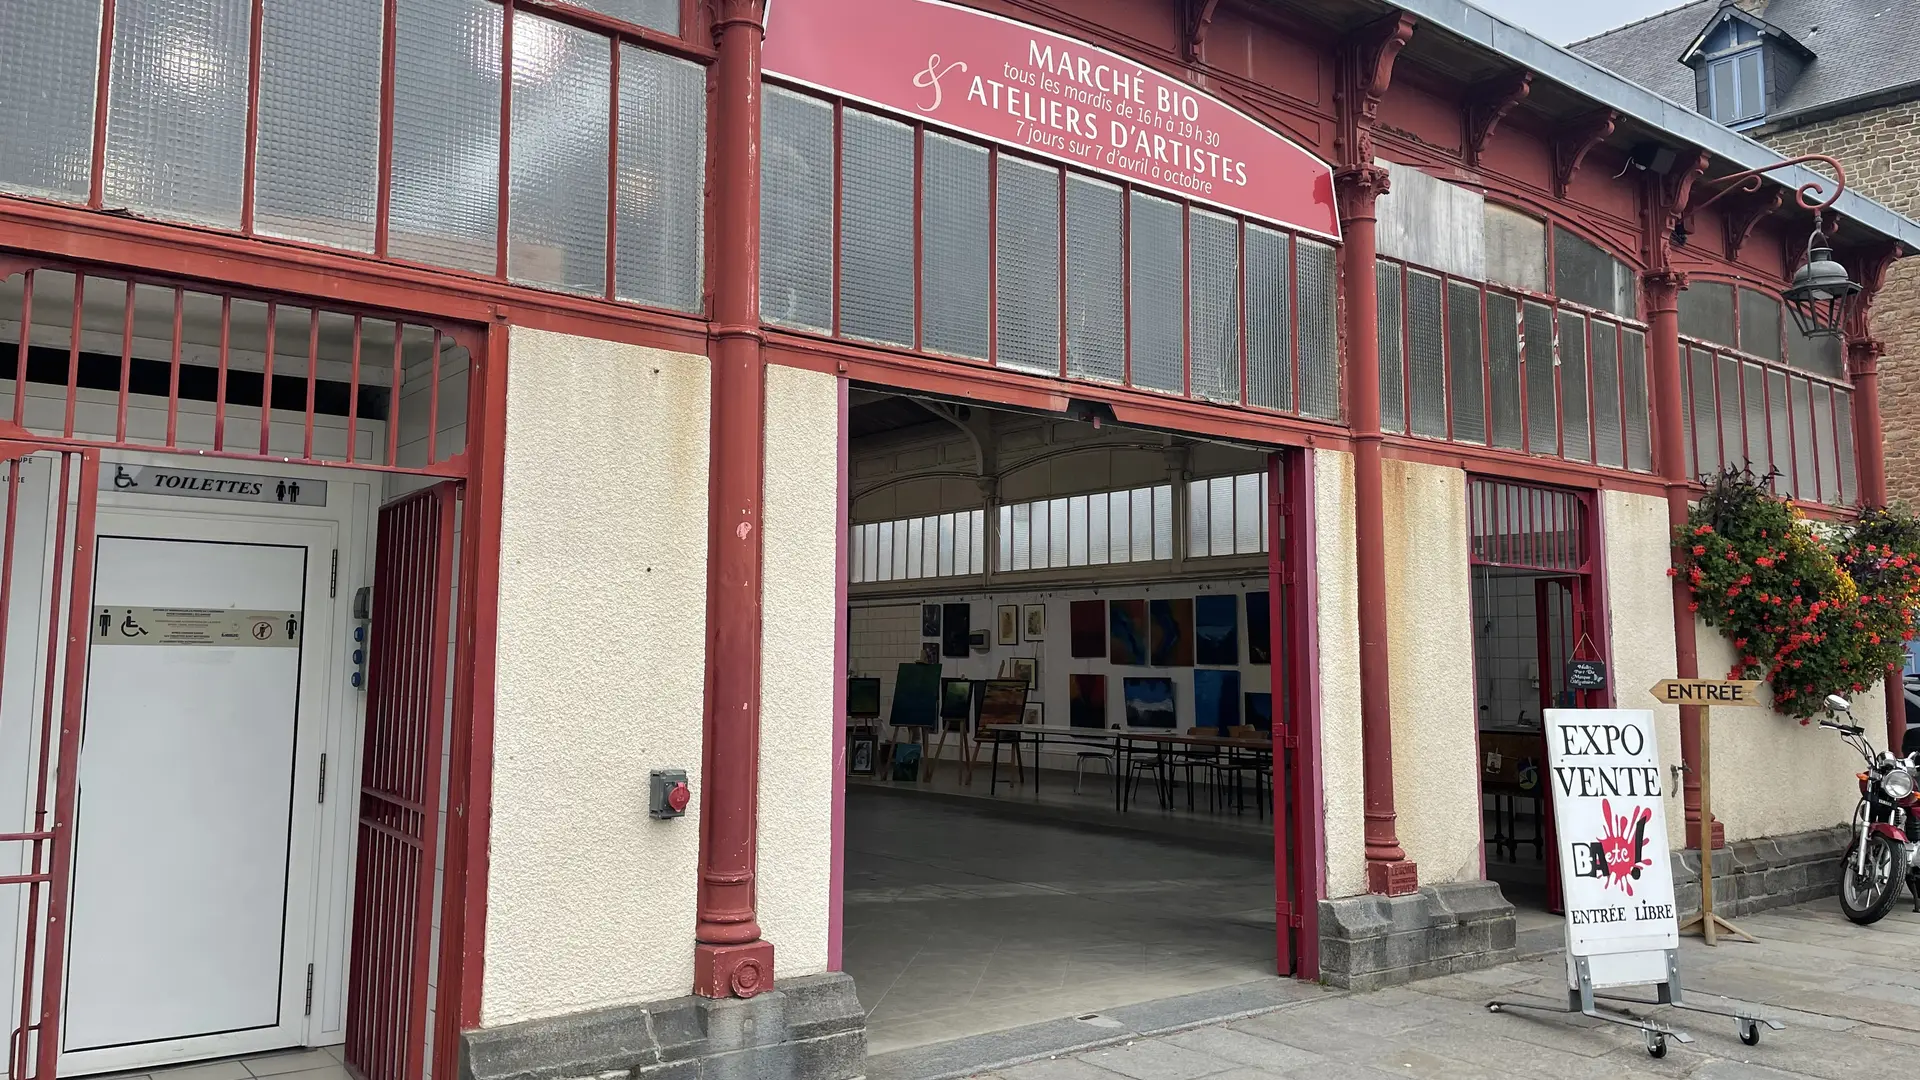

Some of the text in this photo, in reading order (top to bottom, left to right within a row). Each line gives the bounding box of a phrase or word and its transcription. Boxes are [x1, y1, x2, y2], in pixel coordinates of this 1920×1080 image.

[1028, 39, 1199, 121] MARCHÉ BIO
[912, 53, 1247, 187] & ATELIERS D'ARTISTES
[1003, 61, 1036, 87] tous
[1040, 71, 1060, 95] les
[1064, 84, 1113, 112] mardis
[1116, 100, 1133, 119] de
[1136, 107, 1151, 125] 16
[1166, 116, 1174, 133] à
[1177, 121, 1193, 138] 19
[1204, 130, 1220, 148] 30
[1016, 120, 1213, 194] 7 jours sur 7 d'avril à octobre
[154, 474, 263, 496] TOILETTES
[1667, 681, 1743, 701] ENTRÉE
[1558, 723, 1644, 756] EXPO
[1553, 766, 1662, 798] VENTE
[1571, 900, 1674, 925] ENTRÉE LIBRE
